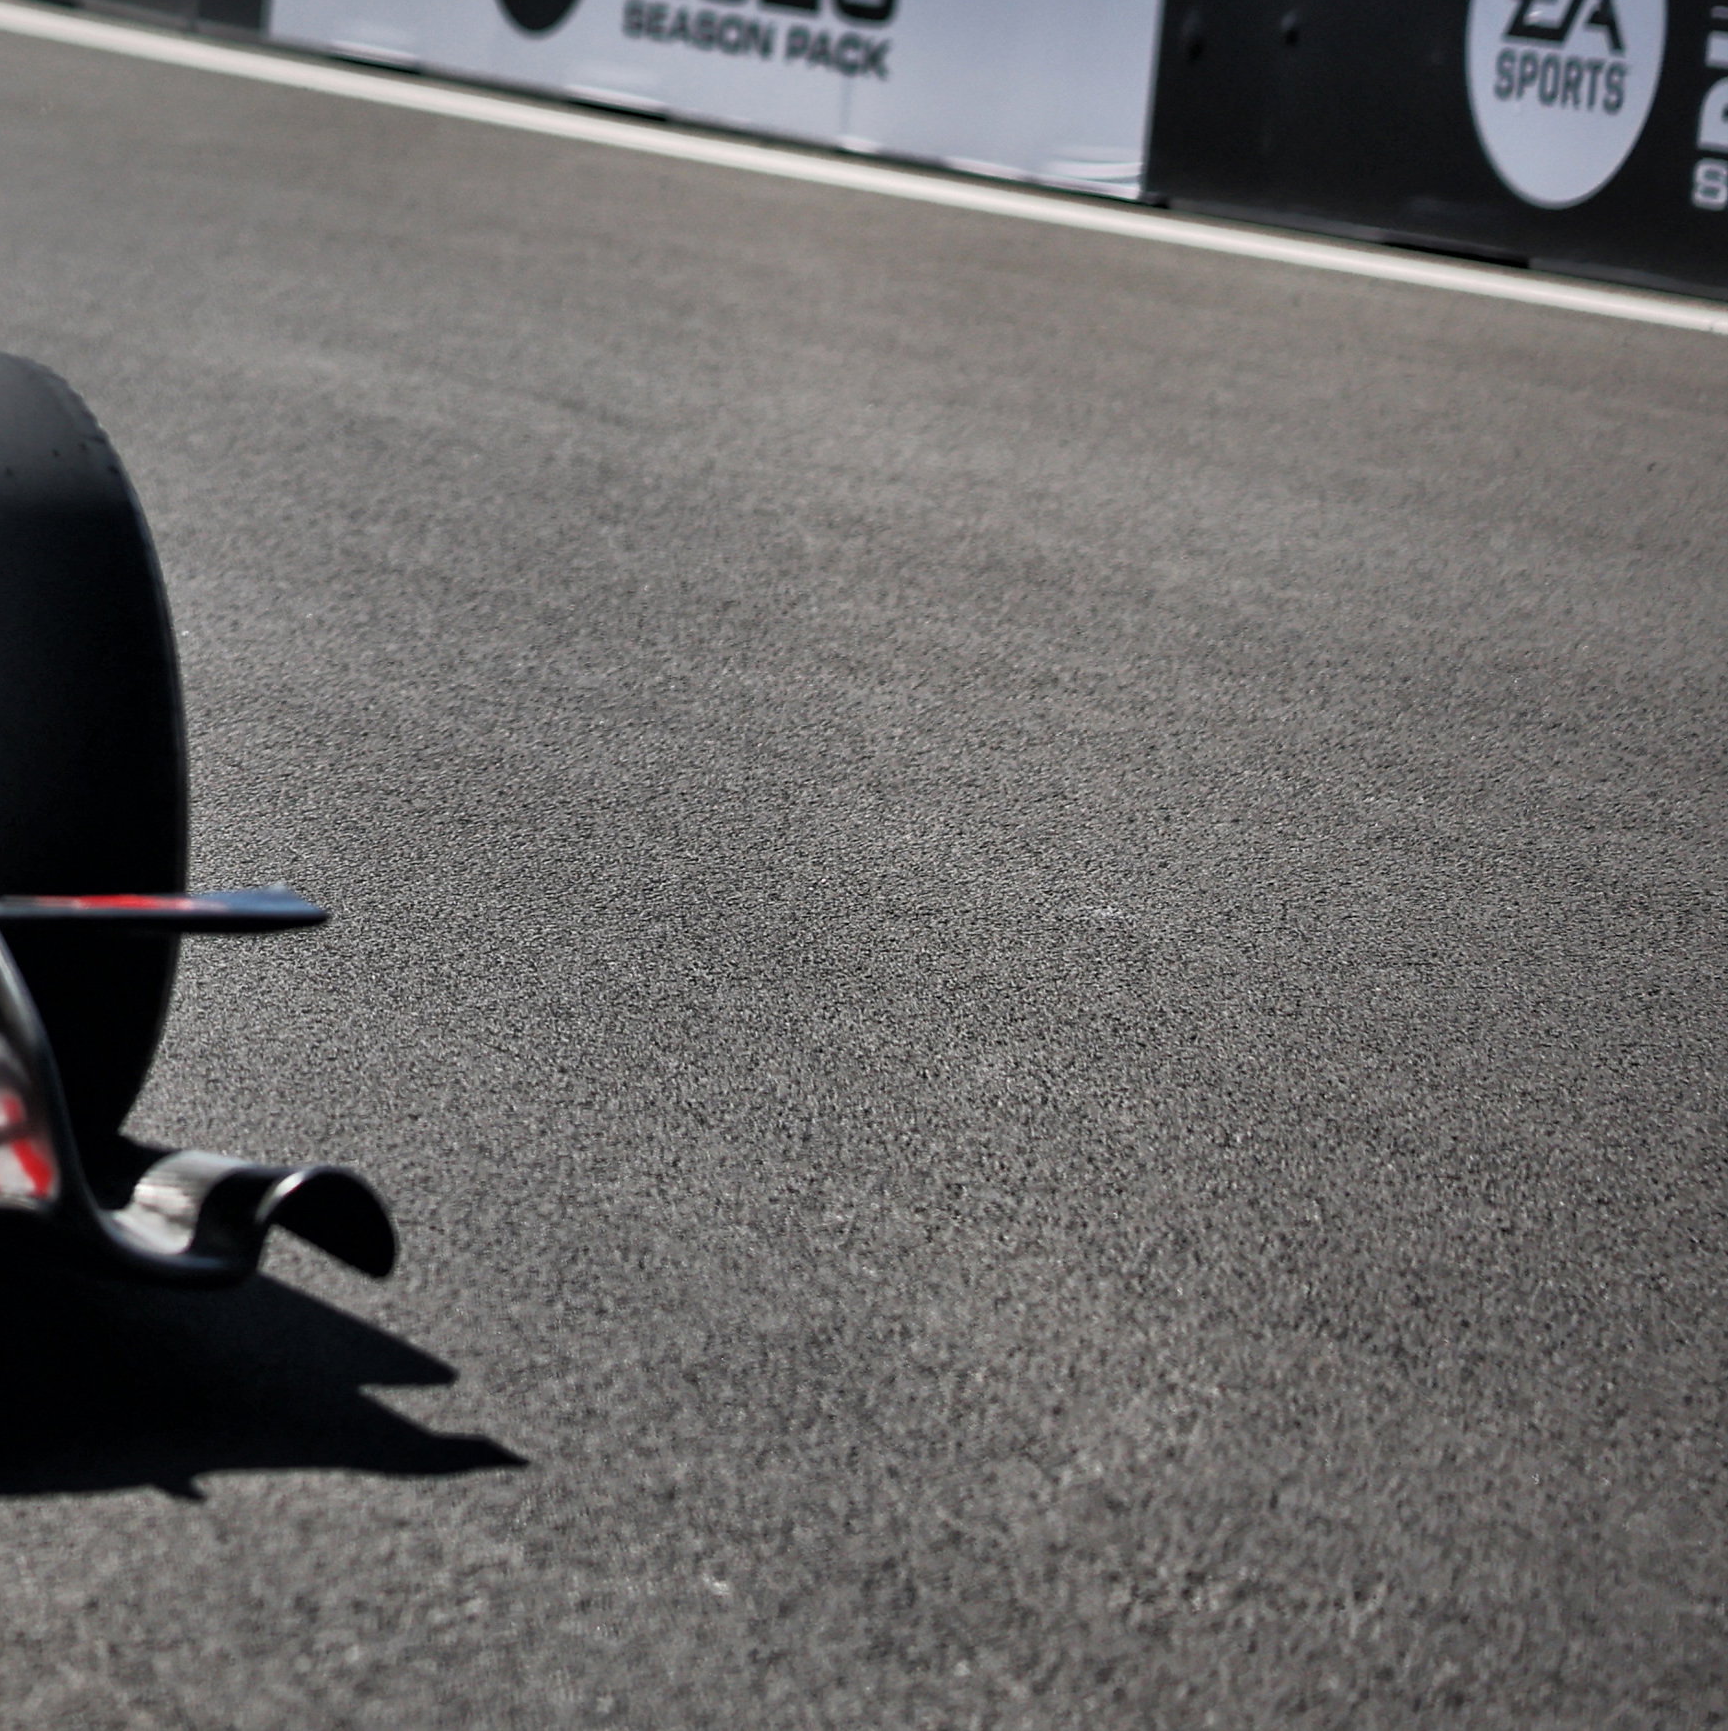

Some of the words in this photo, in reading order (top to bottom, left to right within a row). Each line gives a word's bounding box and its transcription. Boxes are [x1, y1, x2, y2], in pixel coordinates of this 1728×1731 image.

[624, 0, 774, 62] SEASON
[783, 25, 891, 80] PACK
[1494, 47, 1627, 116] SPORTS
